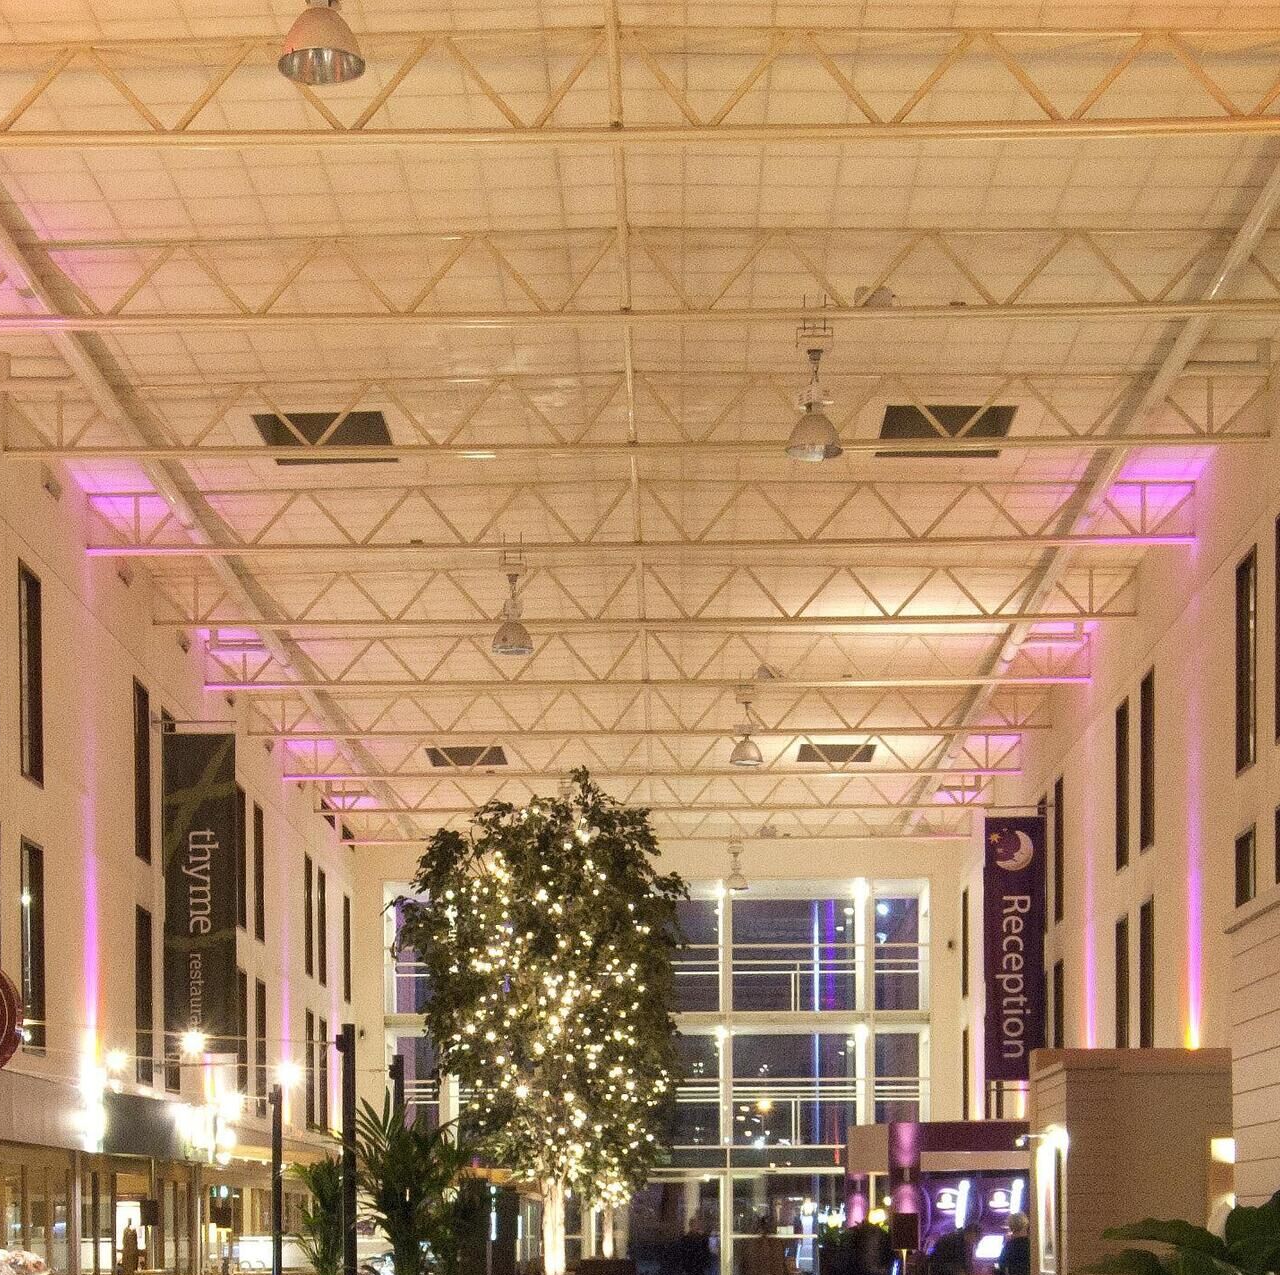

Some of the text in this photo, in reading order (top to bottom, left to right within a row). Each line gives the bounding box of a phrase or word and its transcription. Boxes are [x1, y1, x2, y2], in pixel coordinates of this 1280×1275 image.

[181, 828, 220, 1033] thyme restaura
[995, 895, 1031, 1059] Reception
